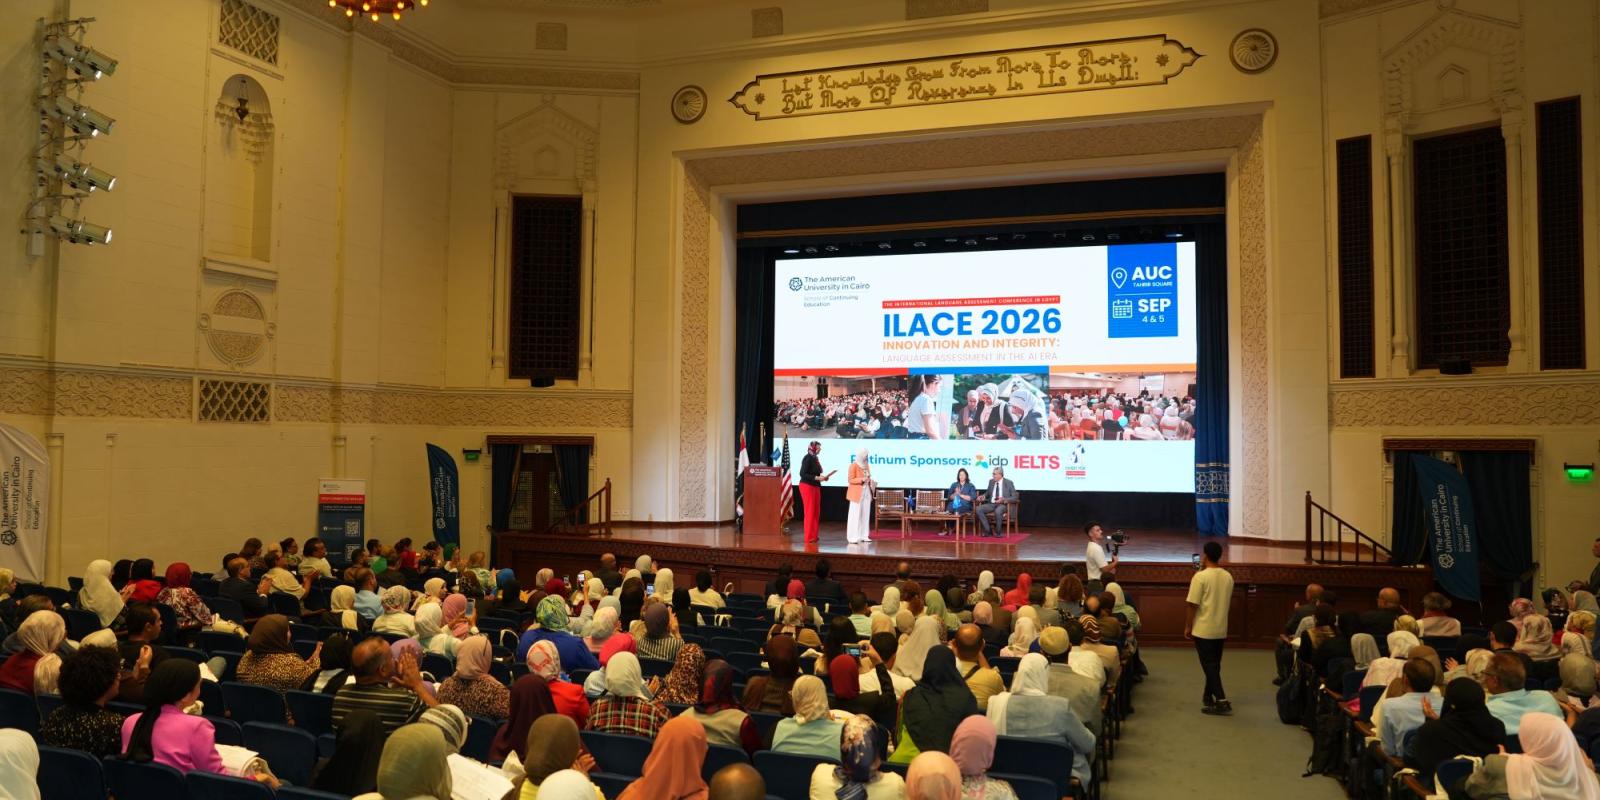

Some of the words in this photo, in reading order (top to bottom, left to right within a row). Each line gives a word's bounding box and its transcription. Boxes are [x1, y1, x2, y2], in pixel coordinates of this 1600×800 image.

[781, 76, 813, 95] Let
[818, 68, 901, 89] Knowledge
[905, 66, 945, 82] Grow
[950, 60, 992, 78] From
[997, 56, 1042, 74] More
[1046, 51, 1071, 70] To
[781, 92, 813, 114] But
[820, 90, 862, 108] More
[869, 86, 897, 105] Of
[907, 81, 997, 101] Reverence
[1006, 73, 1024, 91] In
[1038, 70, 1067, 88] Us
[1132, 265, 1173, 280] AUC
[803, 283, 841, 291] University
[850, 282, 871, 290] Cairo
[1138, 298, 1172, 313] SEP
[883, 312, 973, 337] ILACE
[981, 308, 1062, 335] 2026
[1142, 315, 1148, 323] 4
[1150, 315, 1157, 323] &
[1159, 315, 1165, 323] 5
[882, 339, 960, 350] INNOVATION
[963, 338, 990, 349] AND
[992, 337, 1060, 348] INTEGRITY:
[882, 354, 931, 363] LANGUAGE
[934, 352, 993, 362] ASSESSMENT
[996, 352, 1004, 361] IN
[1005, 352, 1026, 361] THE
[1028, 352, 1039, 360] AI
[1040, 351, 1058, 360] ERA
[11, 456, 20, 478] Cairo
[851, 454, 907, 465] Ptinum
[910, 455, 972, 467] Sponsors:
[988, 455, 1009, 467] idp
[1014, 455, 1060, 469] IELTS
[12, 479, 20, 487] in
[1, 471, 9, 512] American
[1437, 484, 1447, 505] Cairo
[10, 487, 21, 530] University
[1431, 498, 1442, 536] American
[1442, 514, 1453, 553] University
